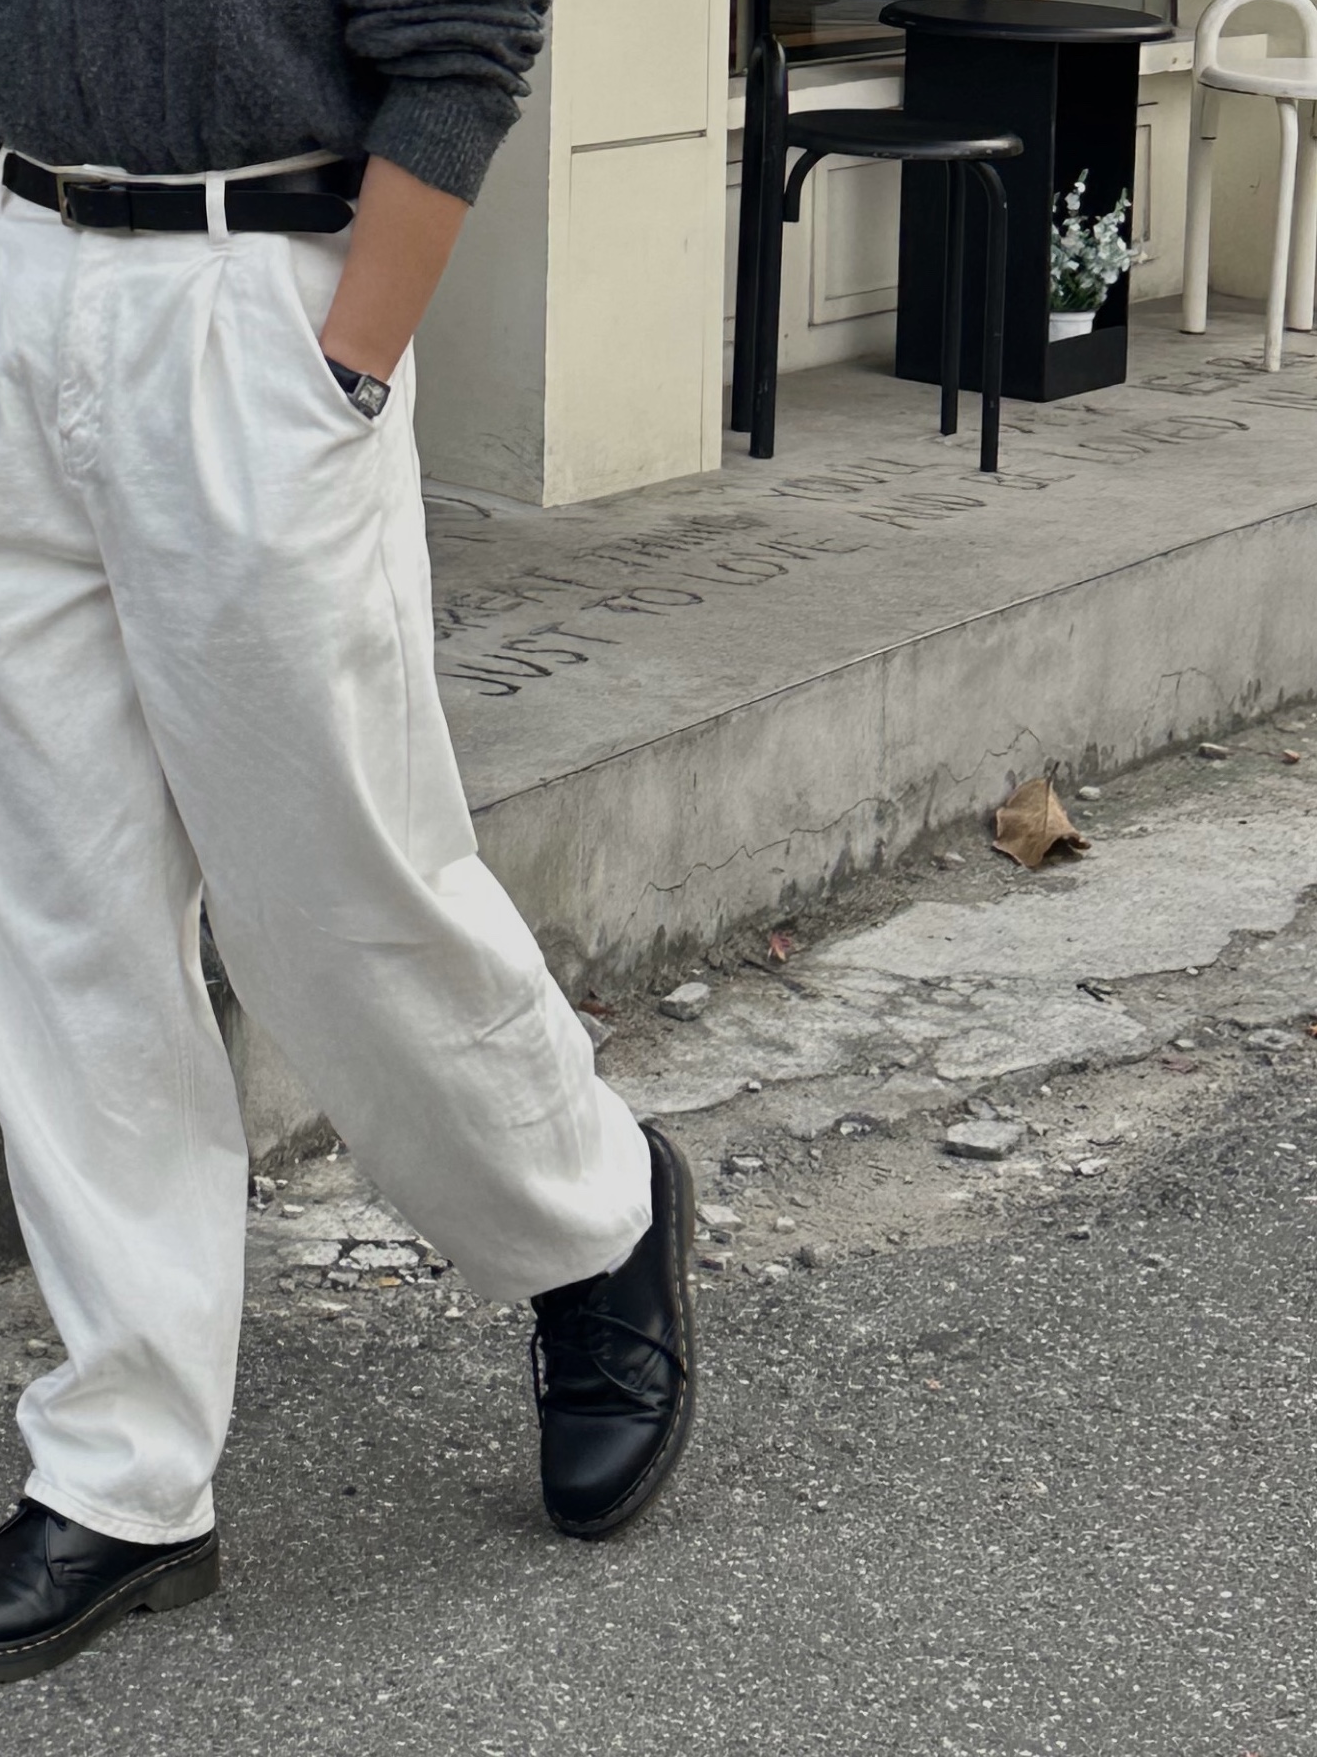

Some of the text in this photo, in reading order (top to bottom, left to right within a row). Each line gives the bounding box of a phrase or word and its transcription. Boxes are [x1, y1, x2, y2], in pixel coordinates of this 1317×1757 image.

[436, 621, 623, 697] JUST
[579, 586, 705, 617] TO
[671, 531, 873, 587] LOVE
